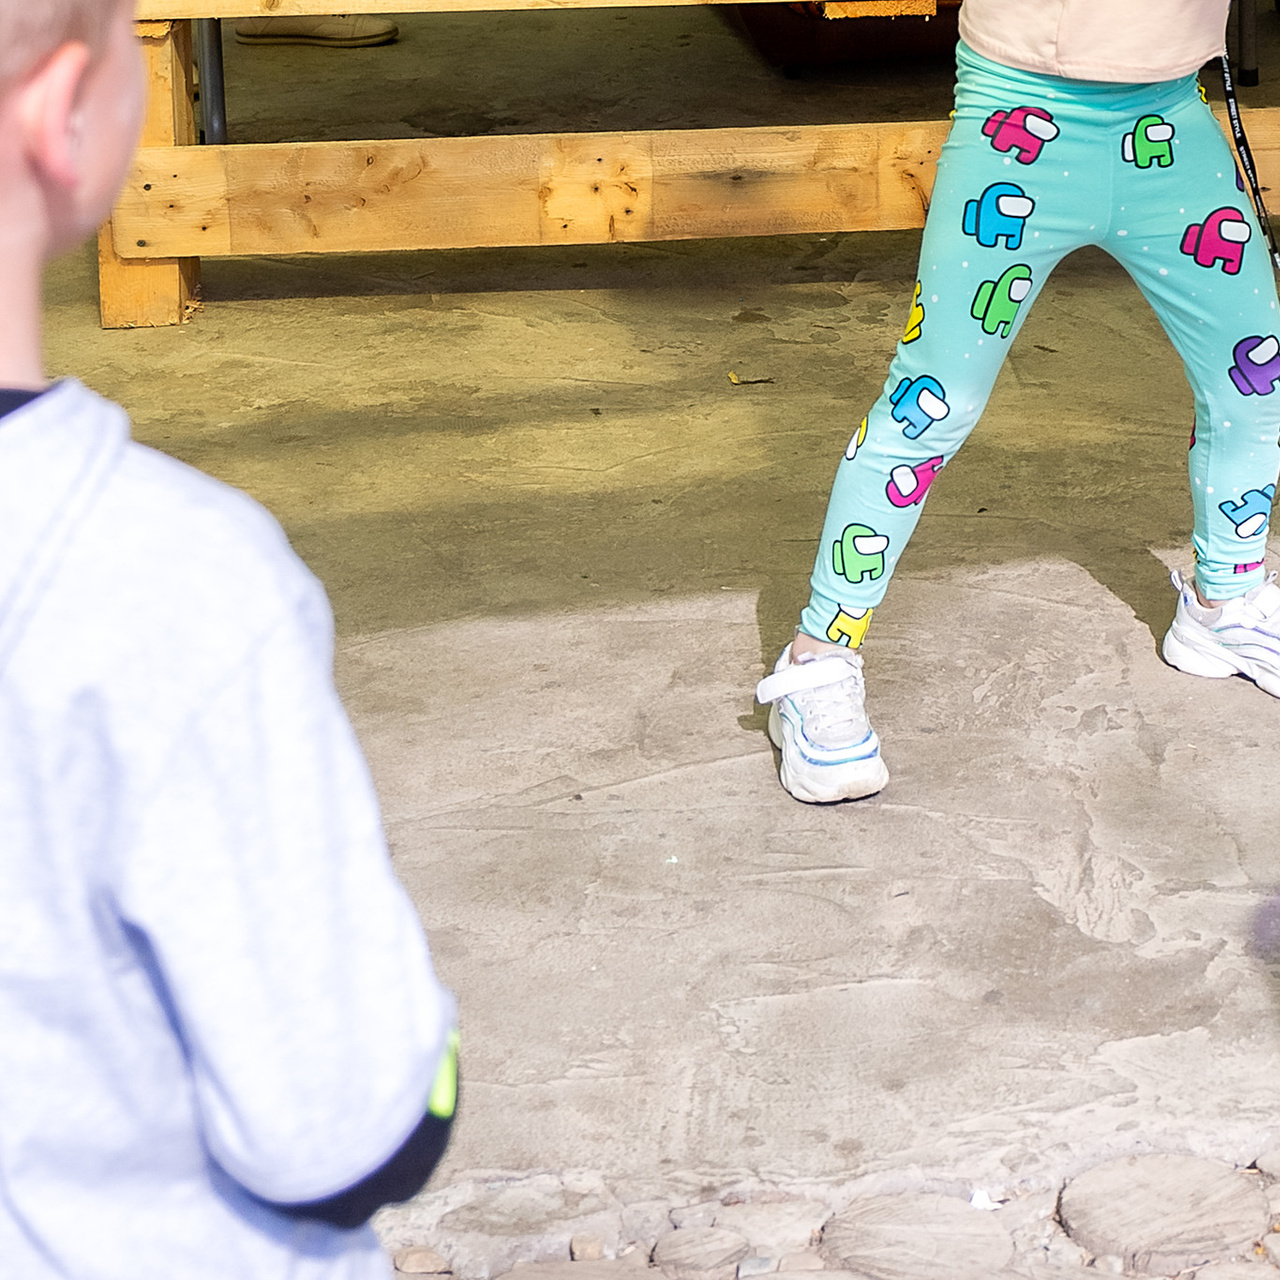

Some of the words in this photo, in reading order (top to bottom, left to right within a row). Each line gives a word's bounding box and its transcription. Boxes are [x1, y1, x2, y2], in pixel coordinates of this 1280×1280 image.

[1224, 72, 1233, 91] STYLE
[1228, 98, 1238, 119] STREET
[1232, 119, 1242, 139] STYLE
[1239, 145, 1251, 170] STREET
